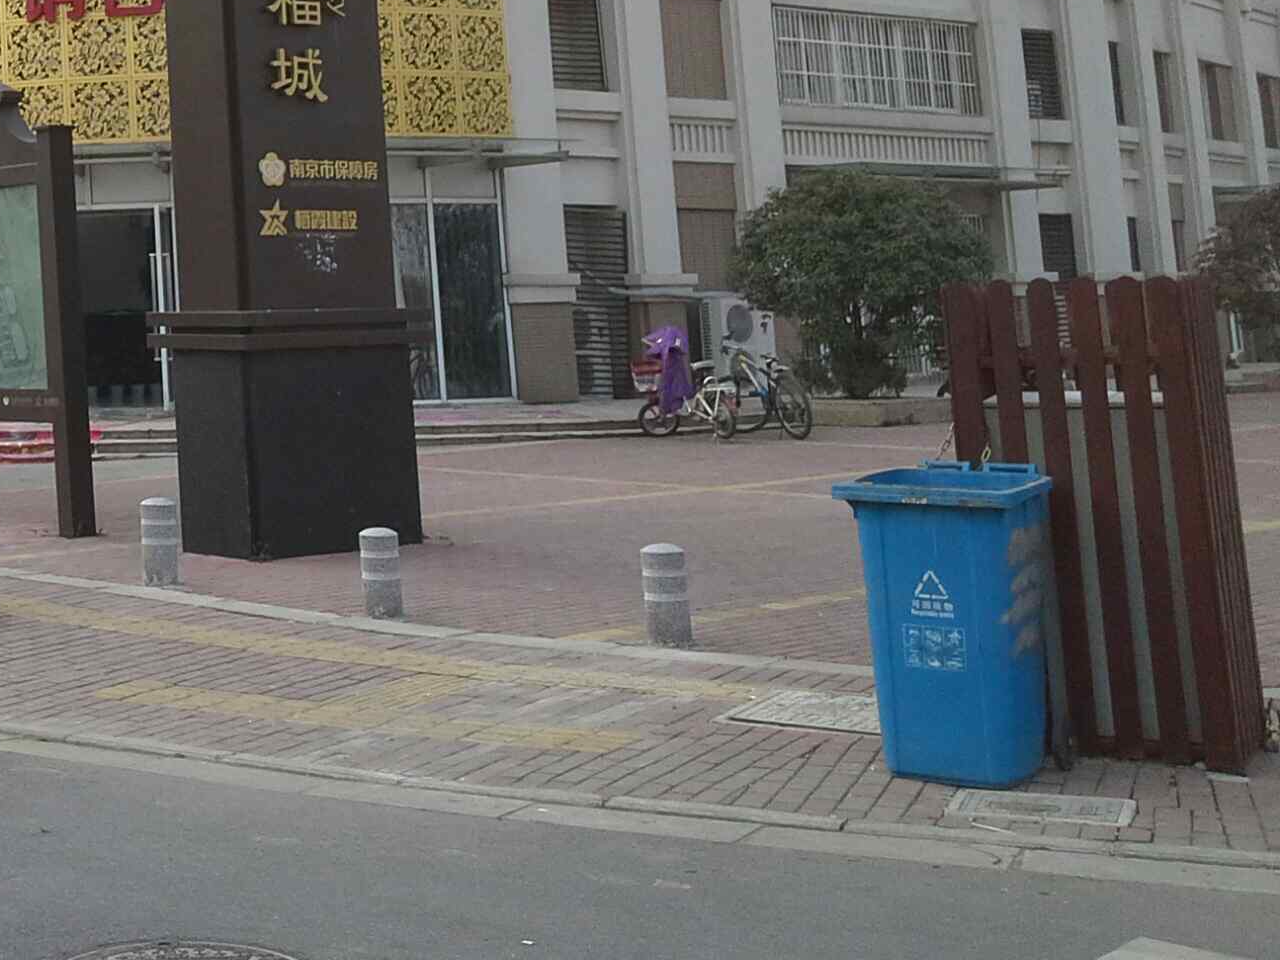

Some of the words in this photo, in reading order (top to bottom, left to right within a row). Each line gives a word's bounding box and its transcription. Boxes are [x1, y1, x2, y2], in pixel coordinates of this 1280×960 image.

[289, 159, 378, 180] 南京市保障房
